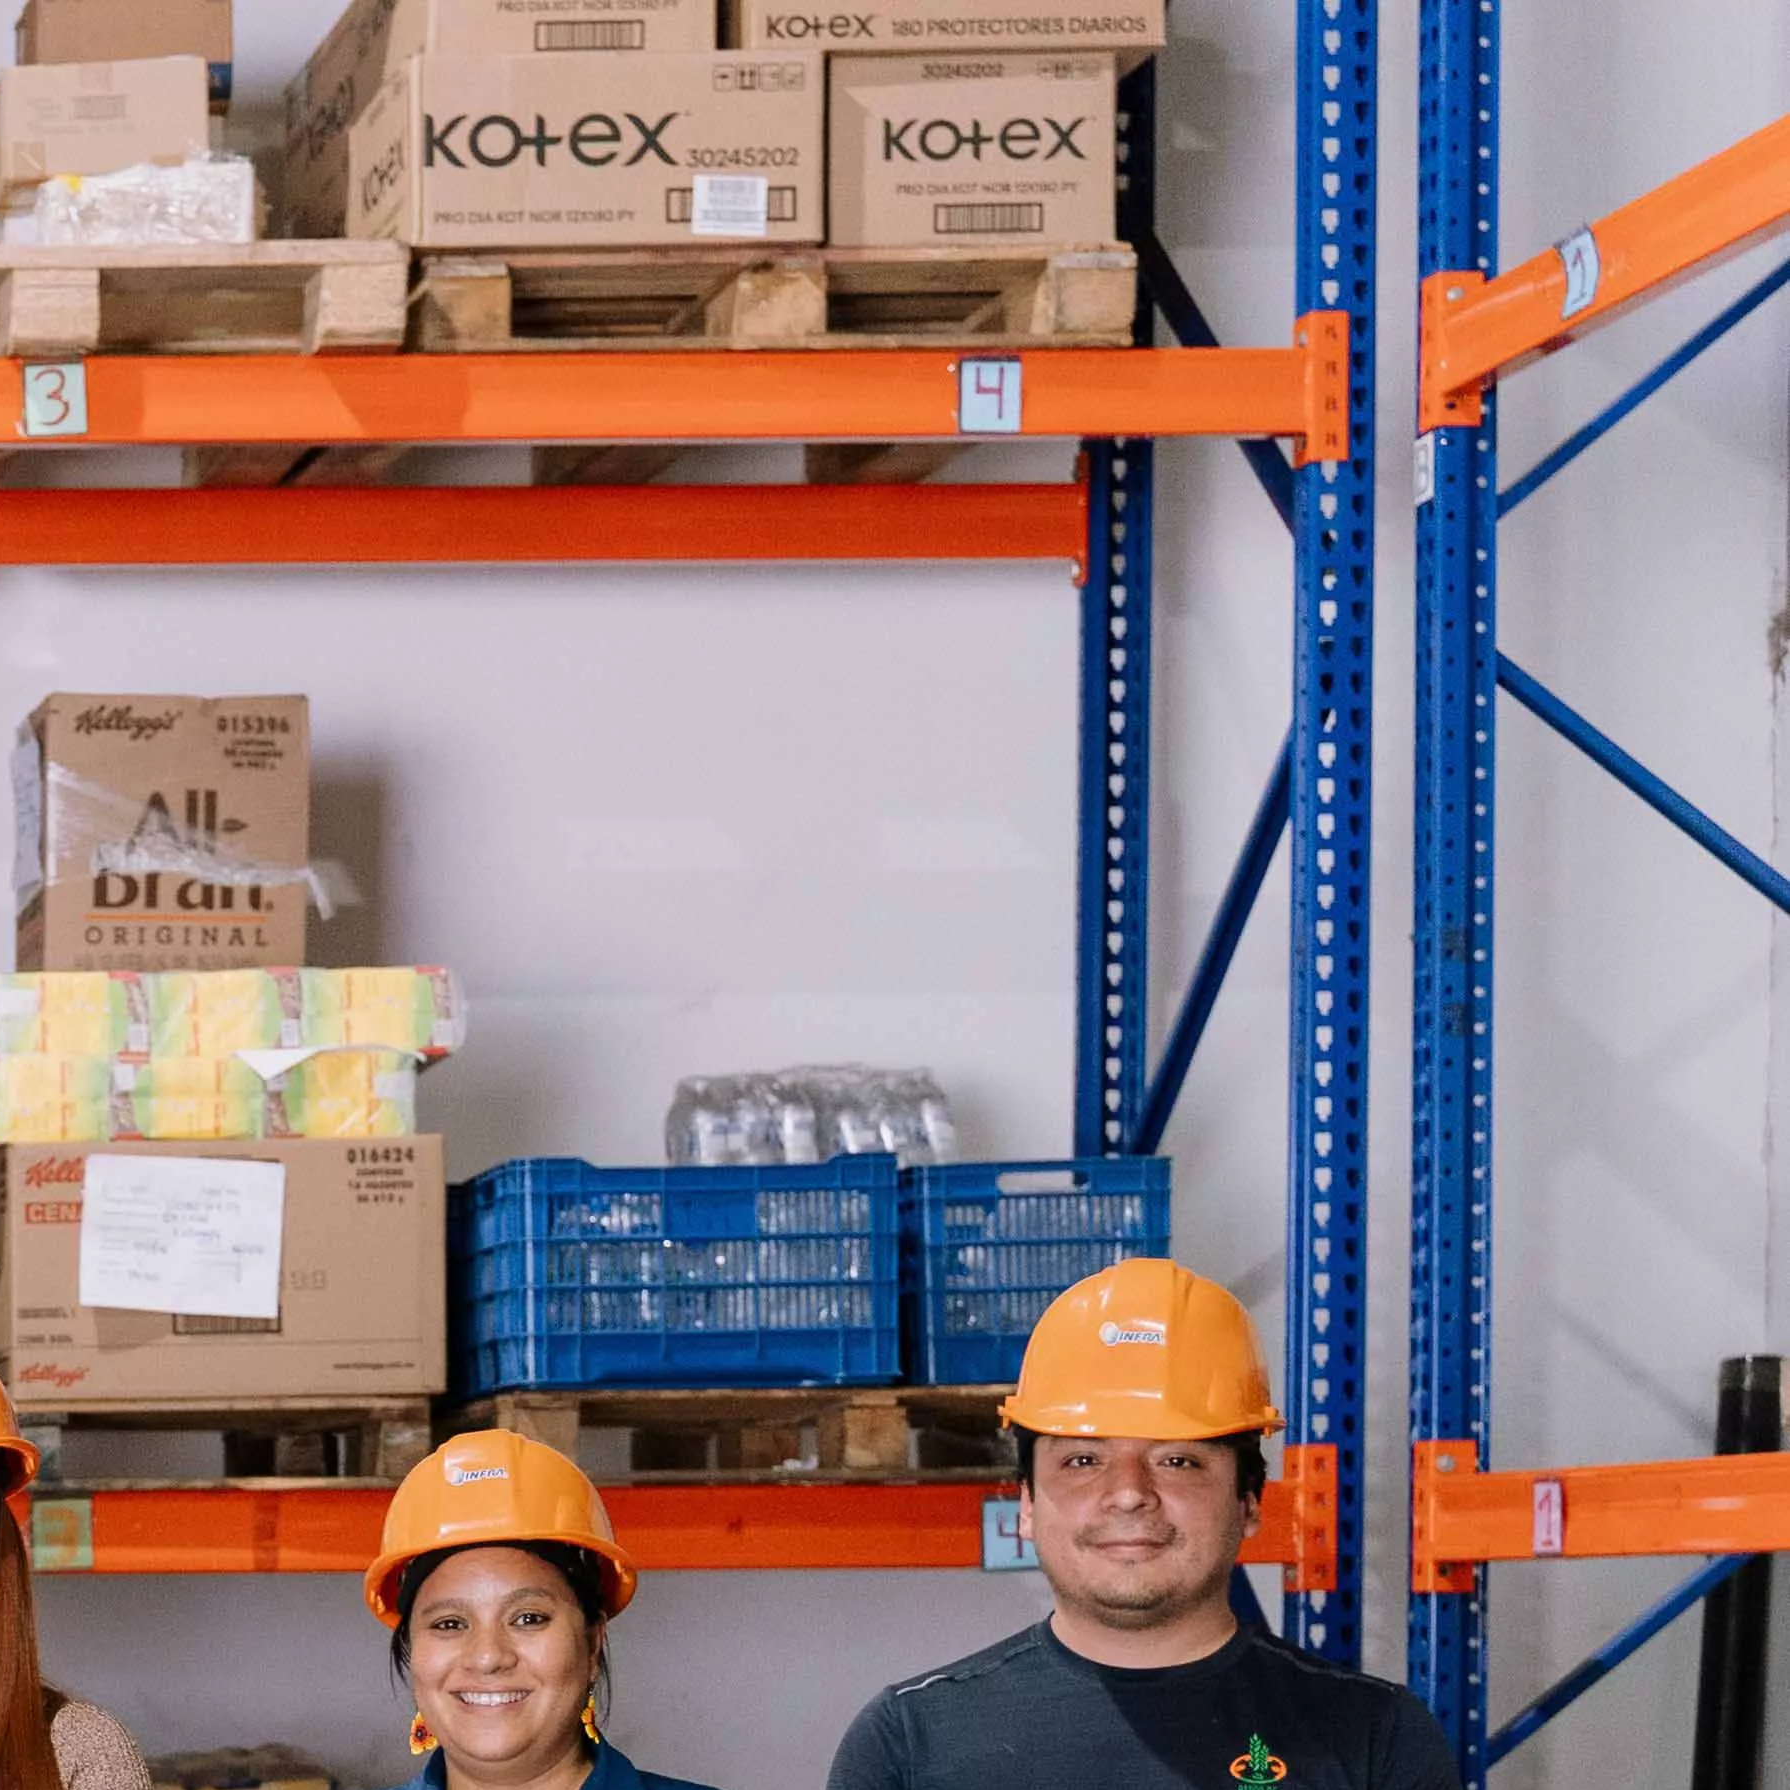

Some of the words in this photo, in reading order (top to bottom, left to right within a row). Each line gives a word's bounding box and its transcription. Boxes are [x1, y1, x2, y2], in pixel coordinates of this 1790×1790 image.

[767, 14, 875, 39] Kotex
[925, 17, 1064, 37] PROTECTORES
[1068, 15, 1147, 34] DIARIOS
[424, 112, 682, 168] Kotex
[685, 147, 800, 168] 30245202
[882, 117, 1088, 161] Kotex
[34, 368, 70, 426] 3
[974, 366, 1004, 419] 4
[75, 705, 183, 741] Kellogg's
[84, 925, 269, 947] ORIGINAL
[996, 1510, 1023, 1559] 4
